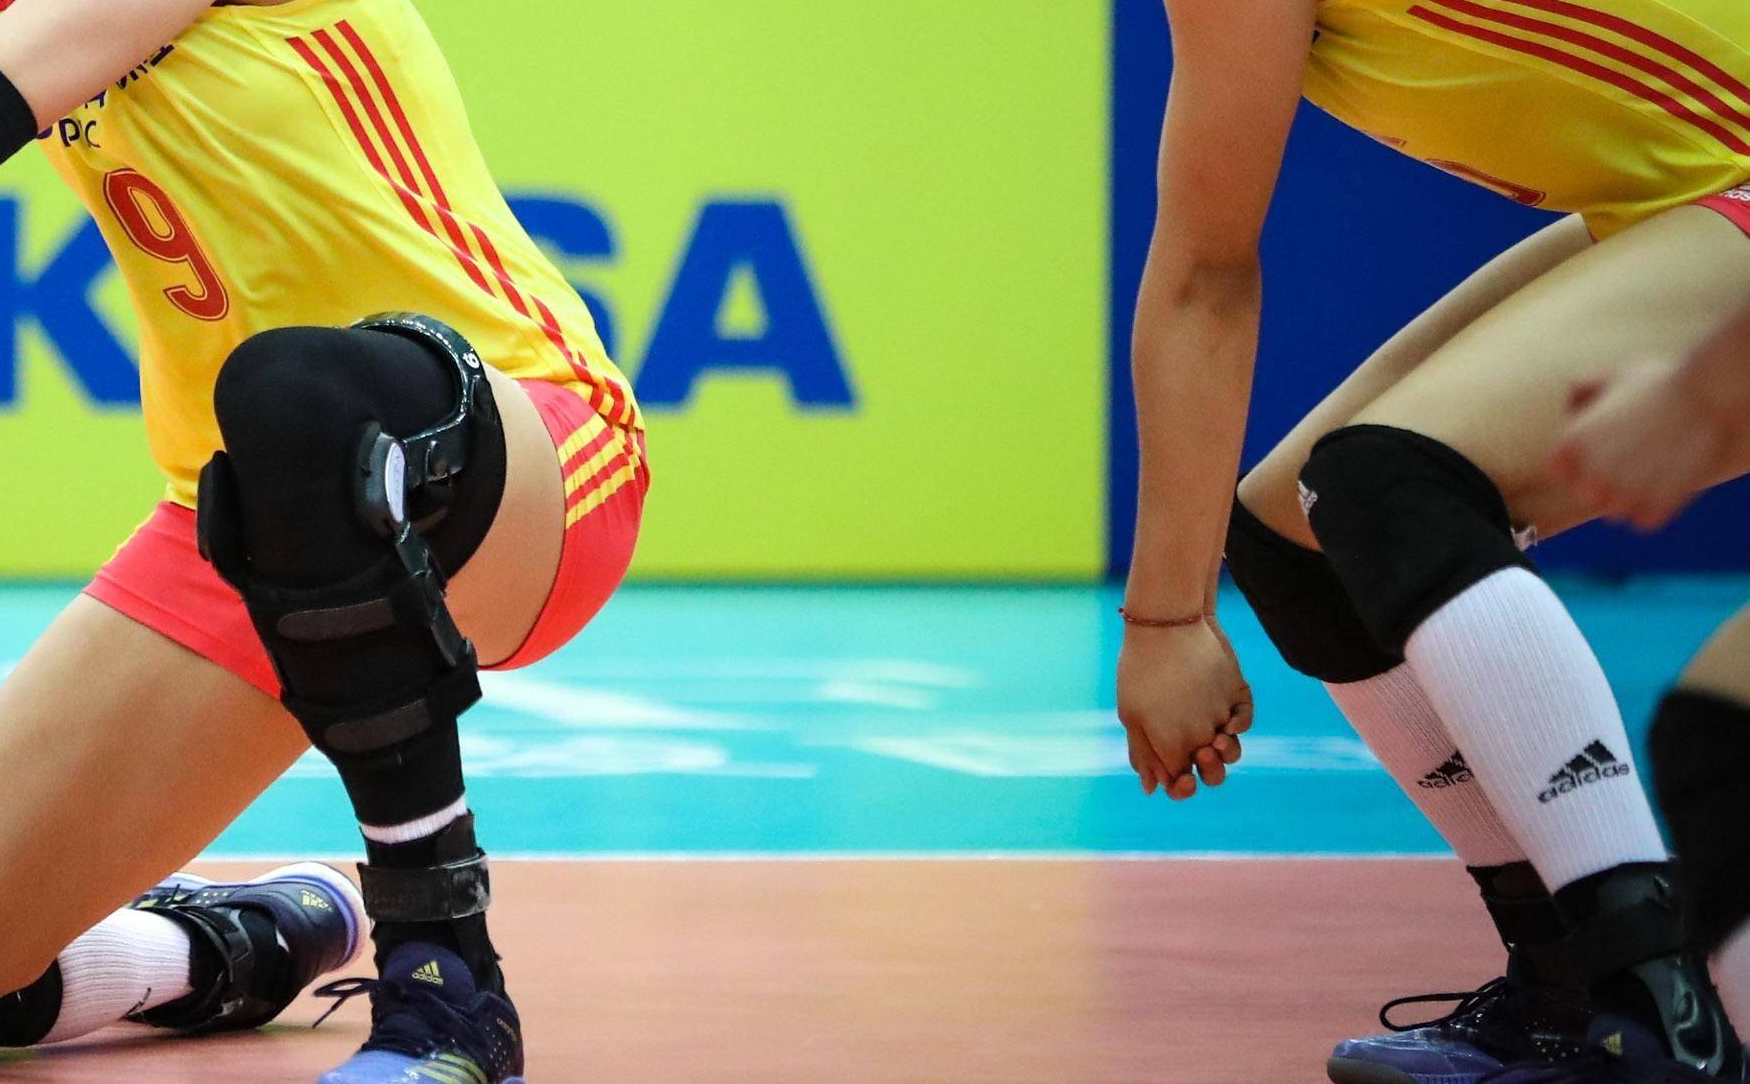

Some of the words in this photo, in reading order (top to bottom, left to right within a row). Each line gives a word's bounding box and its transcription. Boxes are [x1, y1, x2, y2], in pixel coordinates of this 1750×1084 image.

[103, 168, 229, 321] 9
[1417, 768, 1476, 790] adid
[1537, 762, 1630, 804] adidas
[411, 972, 444, 985] adidas
